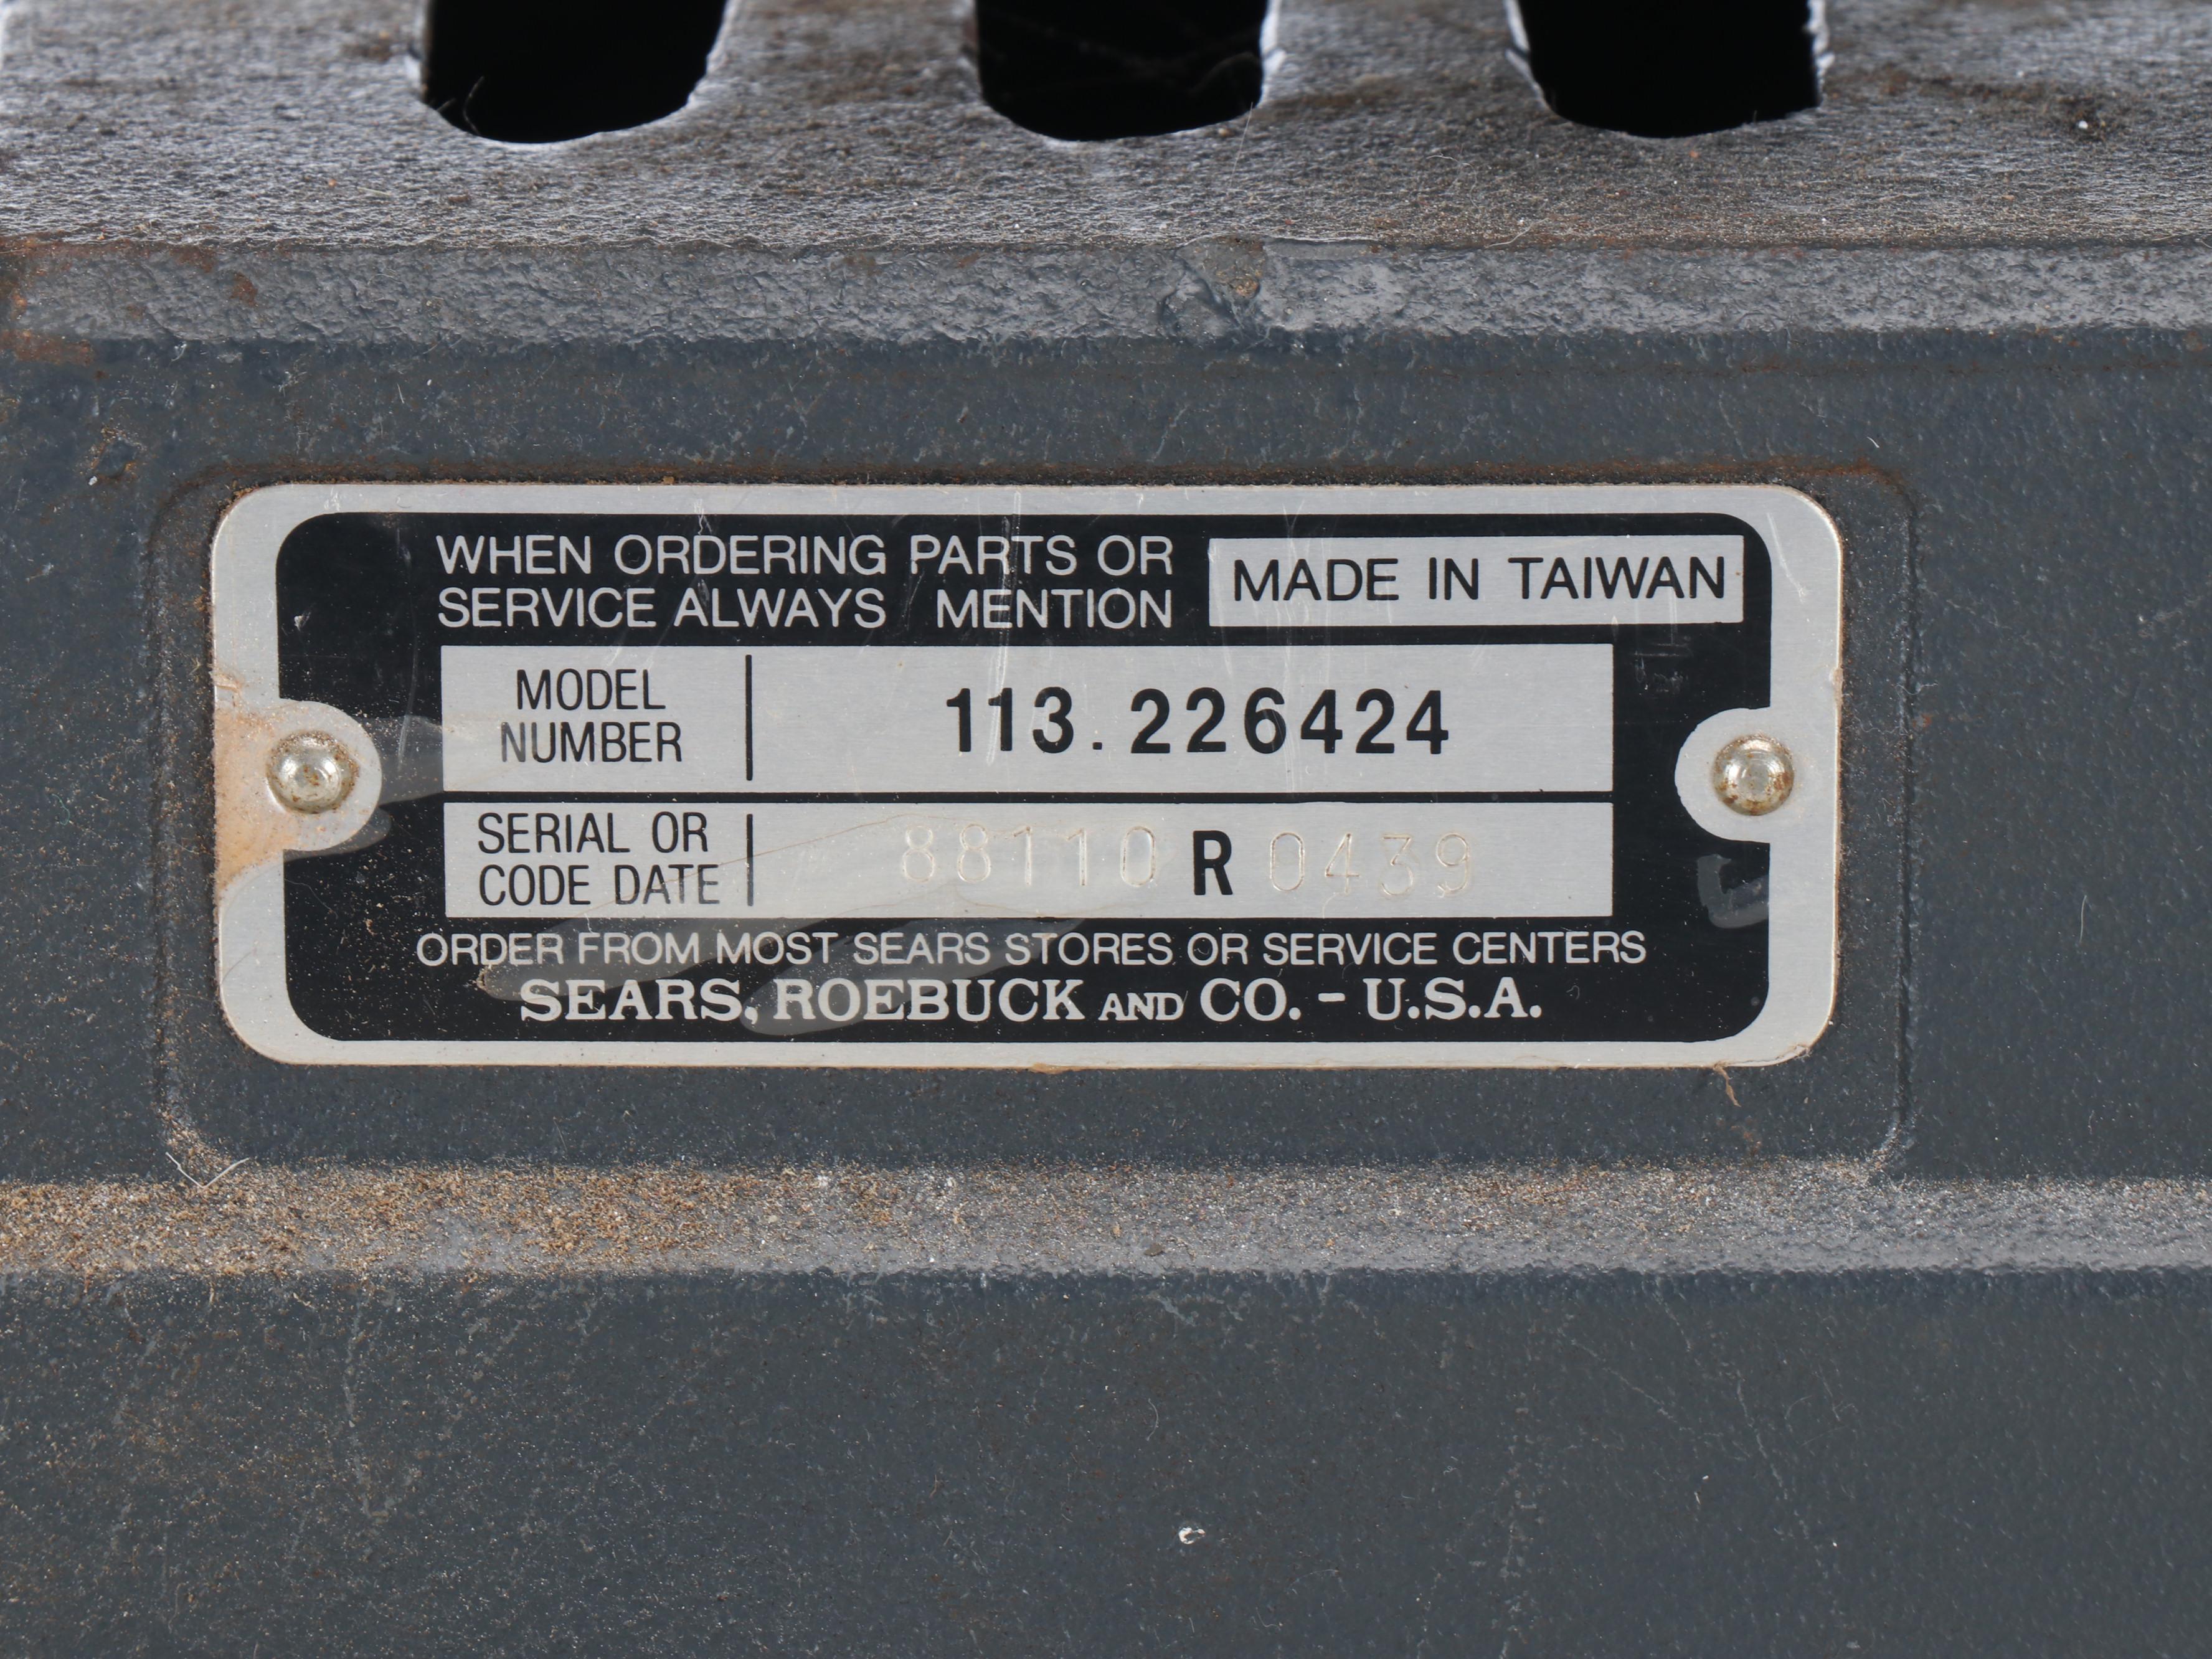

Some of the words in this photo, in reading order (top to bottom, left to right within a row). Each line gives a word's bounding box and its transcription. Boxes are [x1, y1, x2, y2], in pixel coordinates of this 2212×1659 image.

[435, 534, 592, 575] WHEN
[614, 534, 887, 575] ORDERING
[910, 535, 1076, 575] PARTS
[1097, 534, 1173, 575] OR
[1233, 558, 1400, 603] MADE
[1429, 558, 1480, 601] IN
[1508, 556, 1726, 600] TAIWAN
[437, 587, 656, 628] SERVICE
[673, 587, 887, 629] ALWAYS
[936, 588, 1173, 629] MENTION
[516, 668, 666, 711] MODEL
[500, 721, 683, 763] NUMBER
[945, 686, 1450, 756] 113.226424
[478, 812, 630, 853] SERIAL
[653, 811, 709, 853] OR
[901, 823, 1156, 887] 88110
[1193, 830, 1234, 896] R
[1269, 830, 1472, 897] 0439
[479, 864, 592, 905] CODE
[615, 864, 721, 905] DATE
[416, 931, 564, 967] ORDER
[578, 931, 699, 967] FROM
[717, 931, 838, 967] MOST
[853, 931, 991, 967] SEARS
[1003, 931, 1172, 967] STORES
[1186, 931, 1250, 967] OR
[1262, 931, 1438, 967] SERVICE
[1452, 930, 1647, 966] CENTERS
[519, 978, 759, 1026] SEARS,
[772, 977, 1085, 1023] ROEBUCK
[1097, 991, 1184, 1022] AND
[1199, 976, 1301, 1023] CO.
[1318, 991, 1345, 1002] -
[1363, 976, 1543, 1022] U.S.A.
